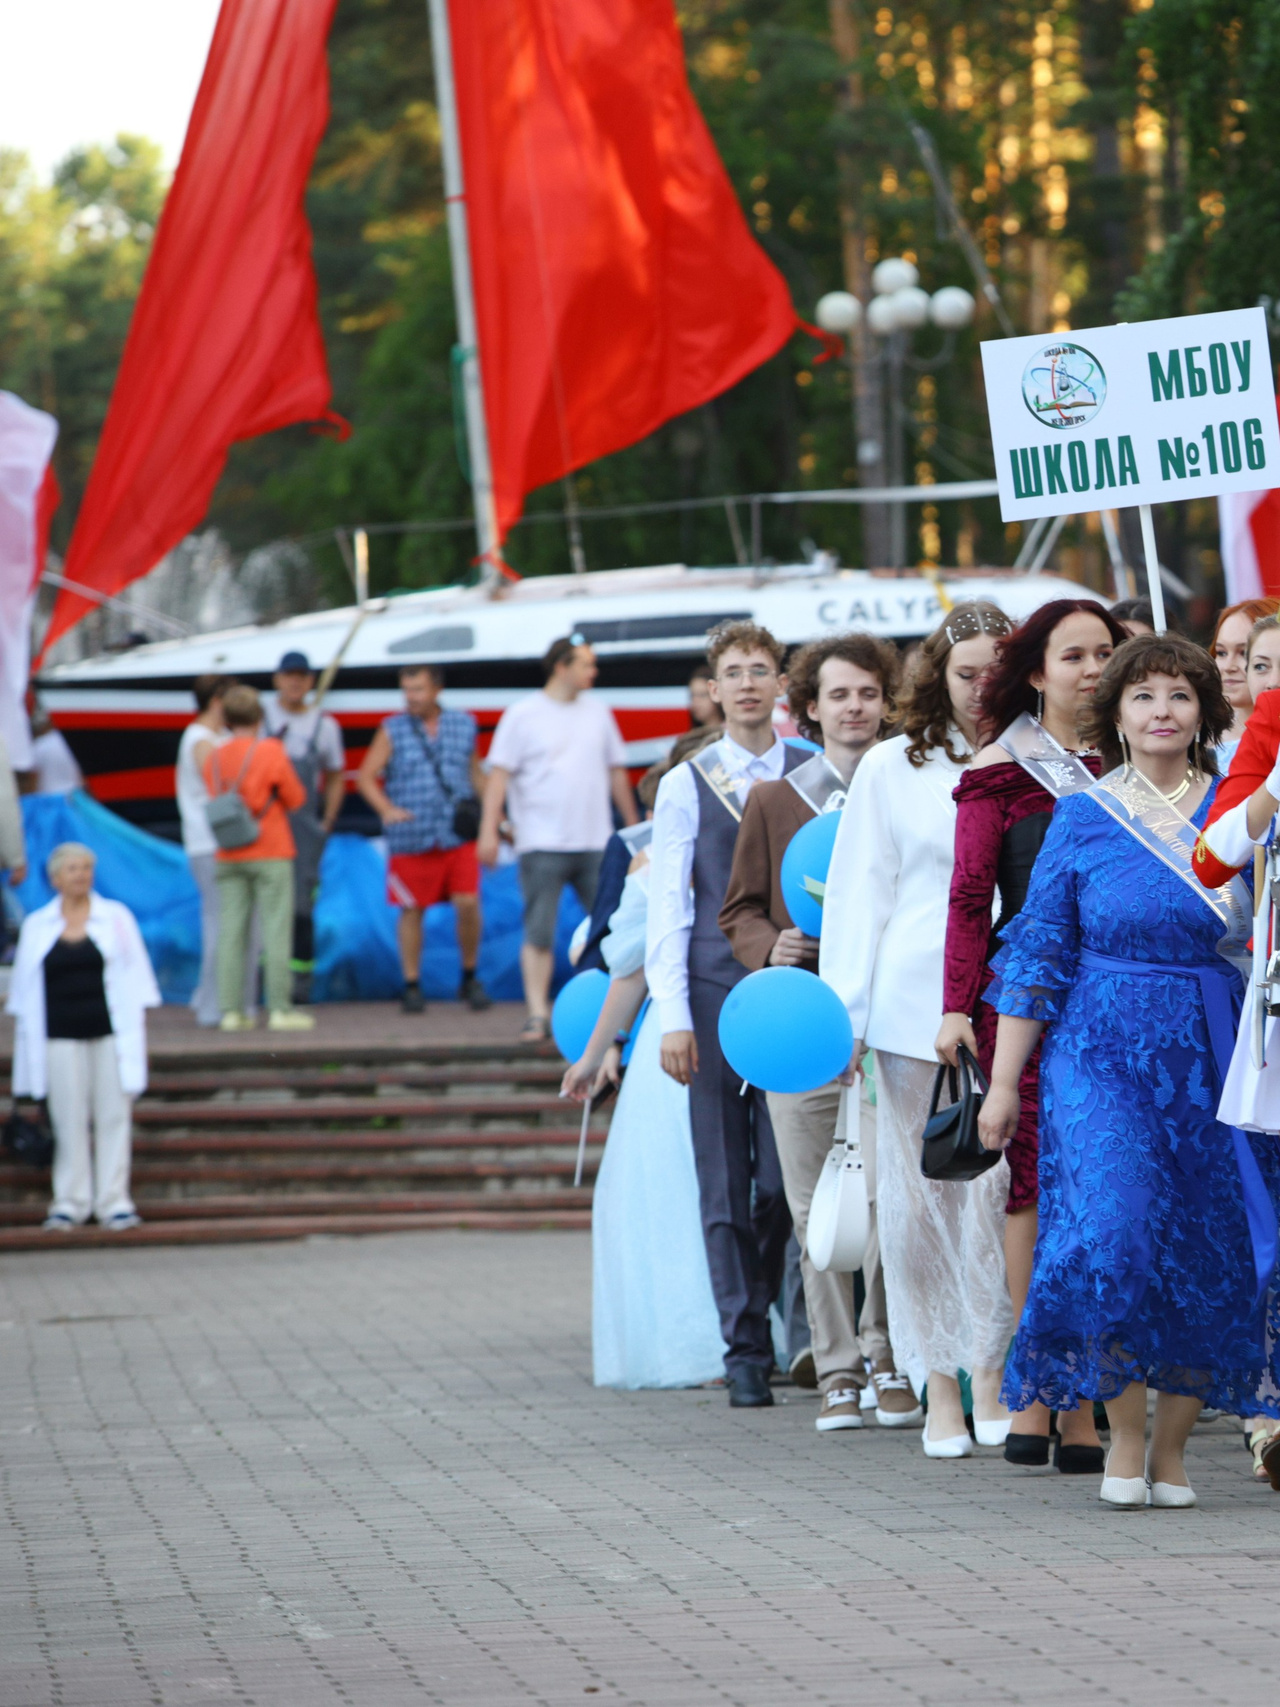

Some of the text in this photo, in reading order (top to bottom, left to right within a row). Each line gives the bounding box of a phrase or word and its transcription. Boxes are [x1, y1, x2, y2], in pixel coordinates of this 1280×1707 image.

[1148, 340, 1251, 402] МБОУ
[1010, 418, 1266, 499] ШКОЛА №106
